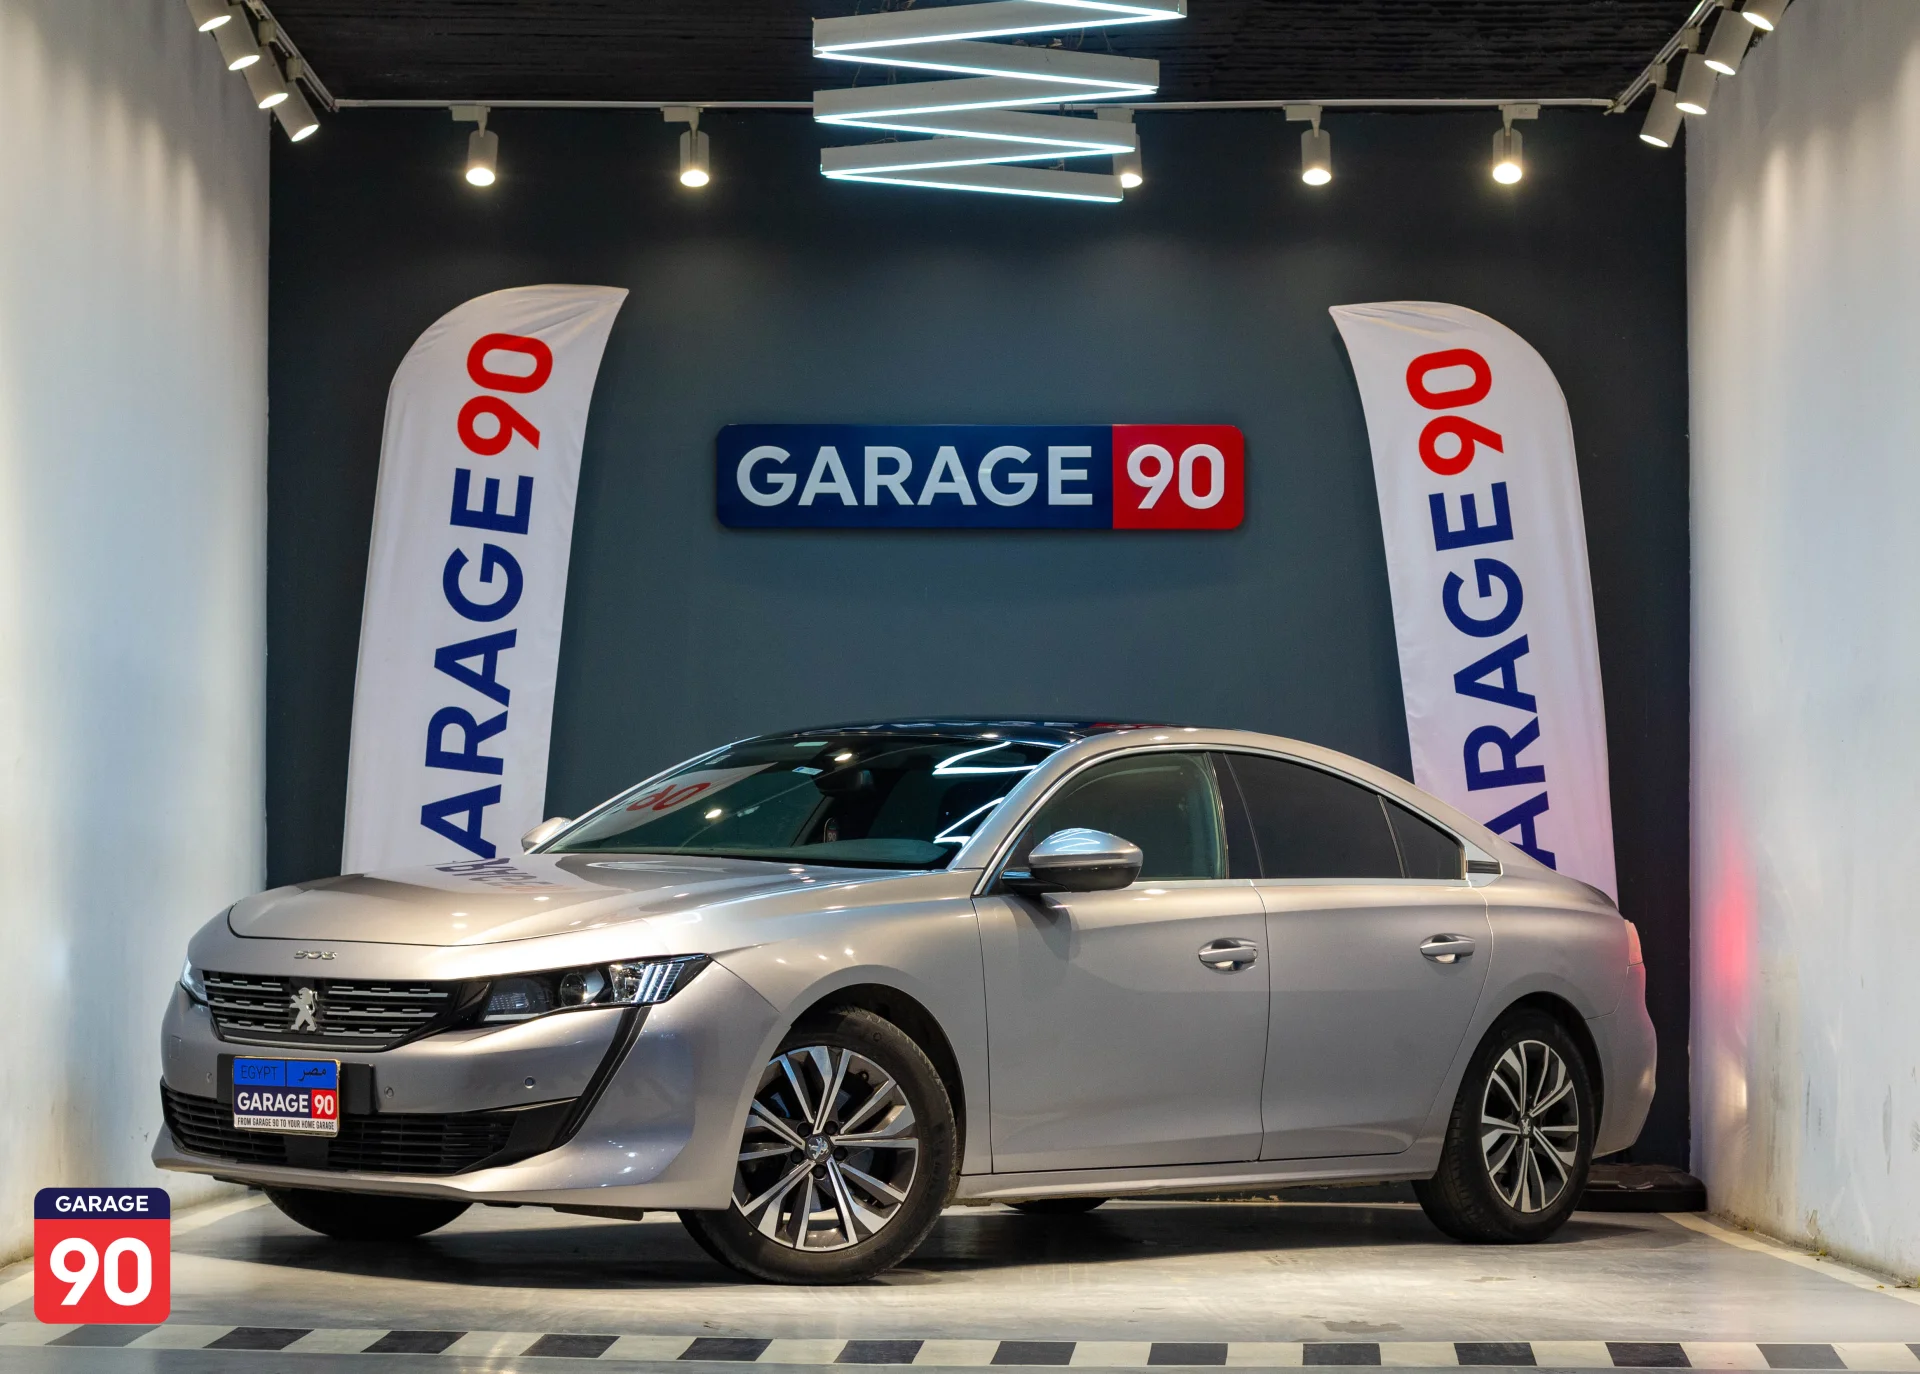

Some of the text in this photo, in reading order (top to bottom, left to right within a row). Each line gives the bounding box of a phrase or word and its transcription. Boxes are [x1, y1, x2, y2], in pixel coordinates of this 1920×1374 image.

[736, 443, 1225, 509] GARAGE 90
[241, 1065, 278, 1080] EGYPT
[298, 1067, 327, 1082] مصر
[237, 1092, 335, 1115] GARAGE 90
[237, 1117, 335, 1130] FROM GARAGE 90 TO YOUR HOME GARAGE
